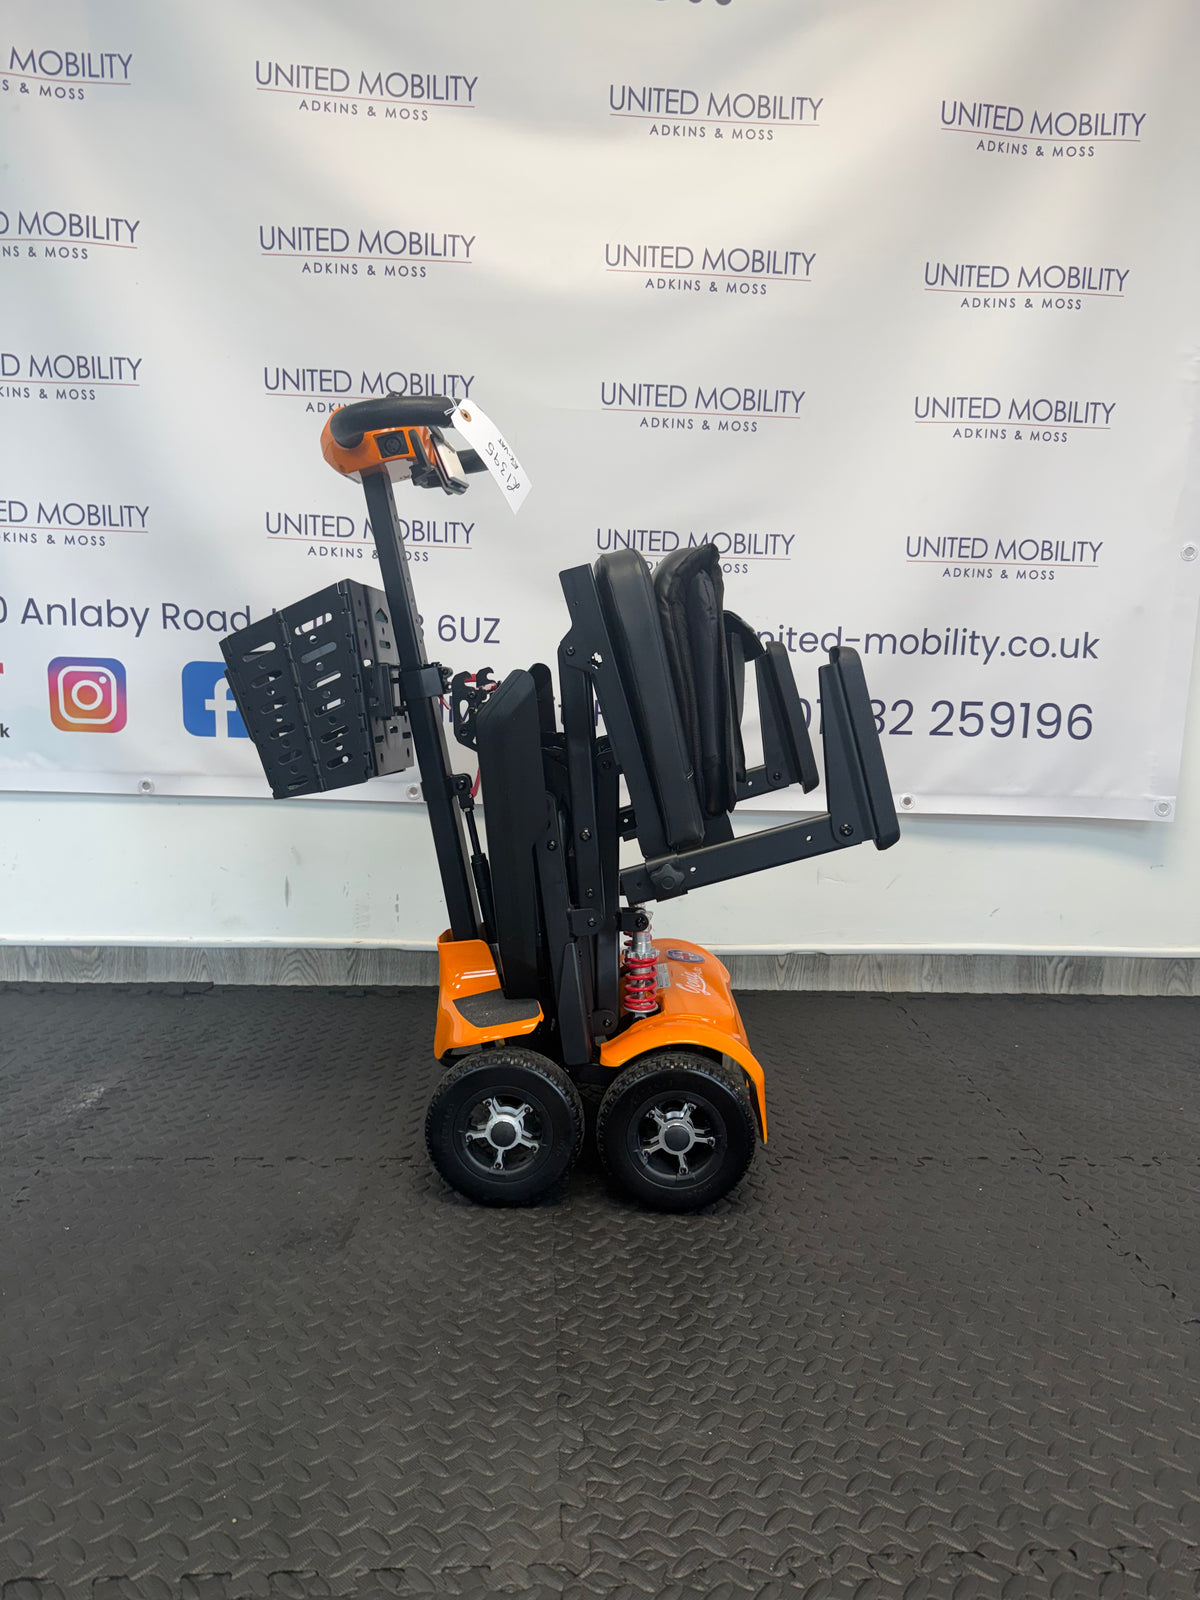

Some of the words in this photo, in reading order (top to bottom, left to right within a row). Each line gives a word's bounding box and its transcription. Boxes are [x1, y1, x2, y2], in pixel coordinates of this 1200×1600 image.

[9, 46, 132, 80] MOBILITY
[19, 82, 30, 94] &
[39, 85, 85, 100] MOSS
[255, 60, 350, 93] UNITED
[358, 71, 478, 102] MOBILITY
[299, 100, 358, 115] ADKINS
[366, 106, 376, 117] &
[385, 108, 429, 121] MOSS
[609, 85, 700, 115] UNITED
[706, 92, 823, 121] MOBILITY
[941, 100, 1024, 132] UNITED
[1029, 111, 1147, 137] MOBILITY
[649, 124, 706, 138] ADKINS
[714, 128, 723, 139] &
[731, 129, 774, 141] MOSS
[976, 140, 1029, 155] ADKINS
[1035, 146, 1044, 156] &
[1052, 146, 1095, 157] MOSS
[18, 211, 140, 243] MOBILITY
[28, 247, 37, 257] &
[45, 247, 88, 259] MOSS
[259, 226, 350, 253] UNITED
[358, 229, 475, 258] MOBILITY
[302, 262, 358, 275] ADKINS
[367, 265, 376, 276] &
[384, 265, 427, 278] MOSS
[605, 244, 694, 270] UNITED
[701, 248, 816, 276] MOBILITY
[645, 278, 701, 291] ADKINS
[709, 281, 718, 292] &
[726, 282, 767, 295] MOSS
[924, 262, 1010, 289] UNITED
[1017, 265, 1130, 292] MOBILITY
[960, 298, 1016, 309] ADKINS
[1025, 298, 1033, 309] &
[1041, 298, 1082, 310] MOSS
[29, 355, 142, 380] MOBILITY
[0, 386, 30, 399] INS
[39, 388, 48, 399] &
[56, 389, 95, 400] MOSS
[264, 367, 352, 393] UNITED
[360, 371, 475, 398] MOBILITY
[601, 382, 687, 408] UNITED
[694, 386, 805, 413] MOBILITY
[914, 396, 1001, 420] UNITED
[1007, 398, 1116, 425] MOBILITY
[640, 417, 694, 429] ADKINS
[702, 420, 710, 430] &
[718, 420, 758, 432] MOSS
[953, 428, 1007, 440] ADKINS
[1014, 430, 1023, 441] &
[1030, 431, 1068, 443] MOSS
[37, 502, 149, 528] MOBILITY
[266, 512, 355, 538] UNITED
[3, 532, 38, 544] KINS
[46, 534, 56, 545] &
[64, 535, 106, 546] MOSS
[308, 546, 363, 558] ADKINS
[597, 528, 680, 552] UNITED
[907, 536, 989, 559] UNITED
[994, 538, 1103, 563] MOBILITY
[722, 563, 748, 574] OSS
[943, 568, 993, 579] ADKINS
[1000, 569, 1009, 580] &
[1016, 570, 1055, 581] MOSS
[21, 597, 150, 638] Anlaby
[437, 614, 501, 644] 6UZ
[756, 624, 1100, 665] nited-mobility.co.uk
[929, 700, 1093, 740] 259196
